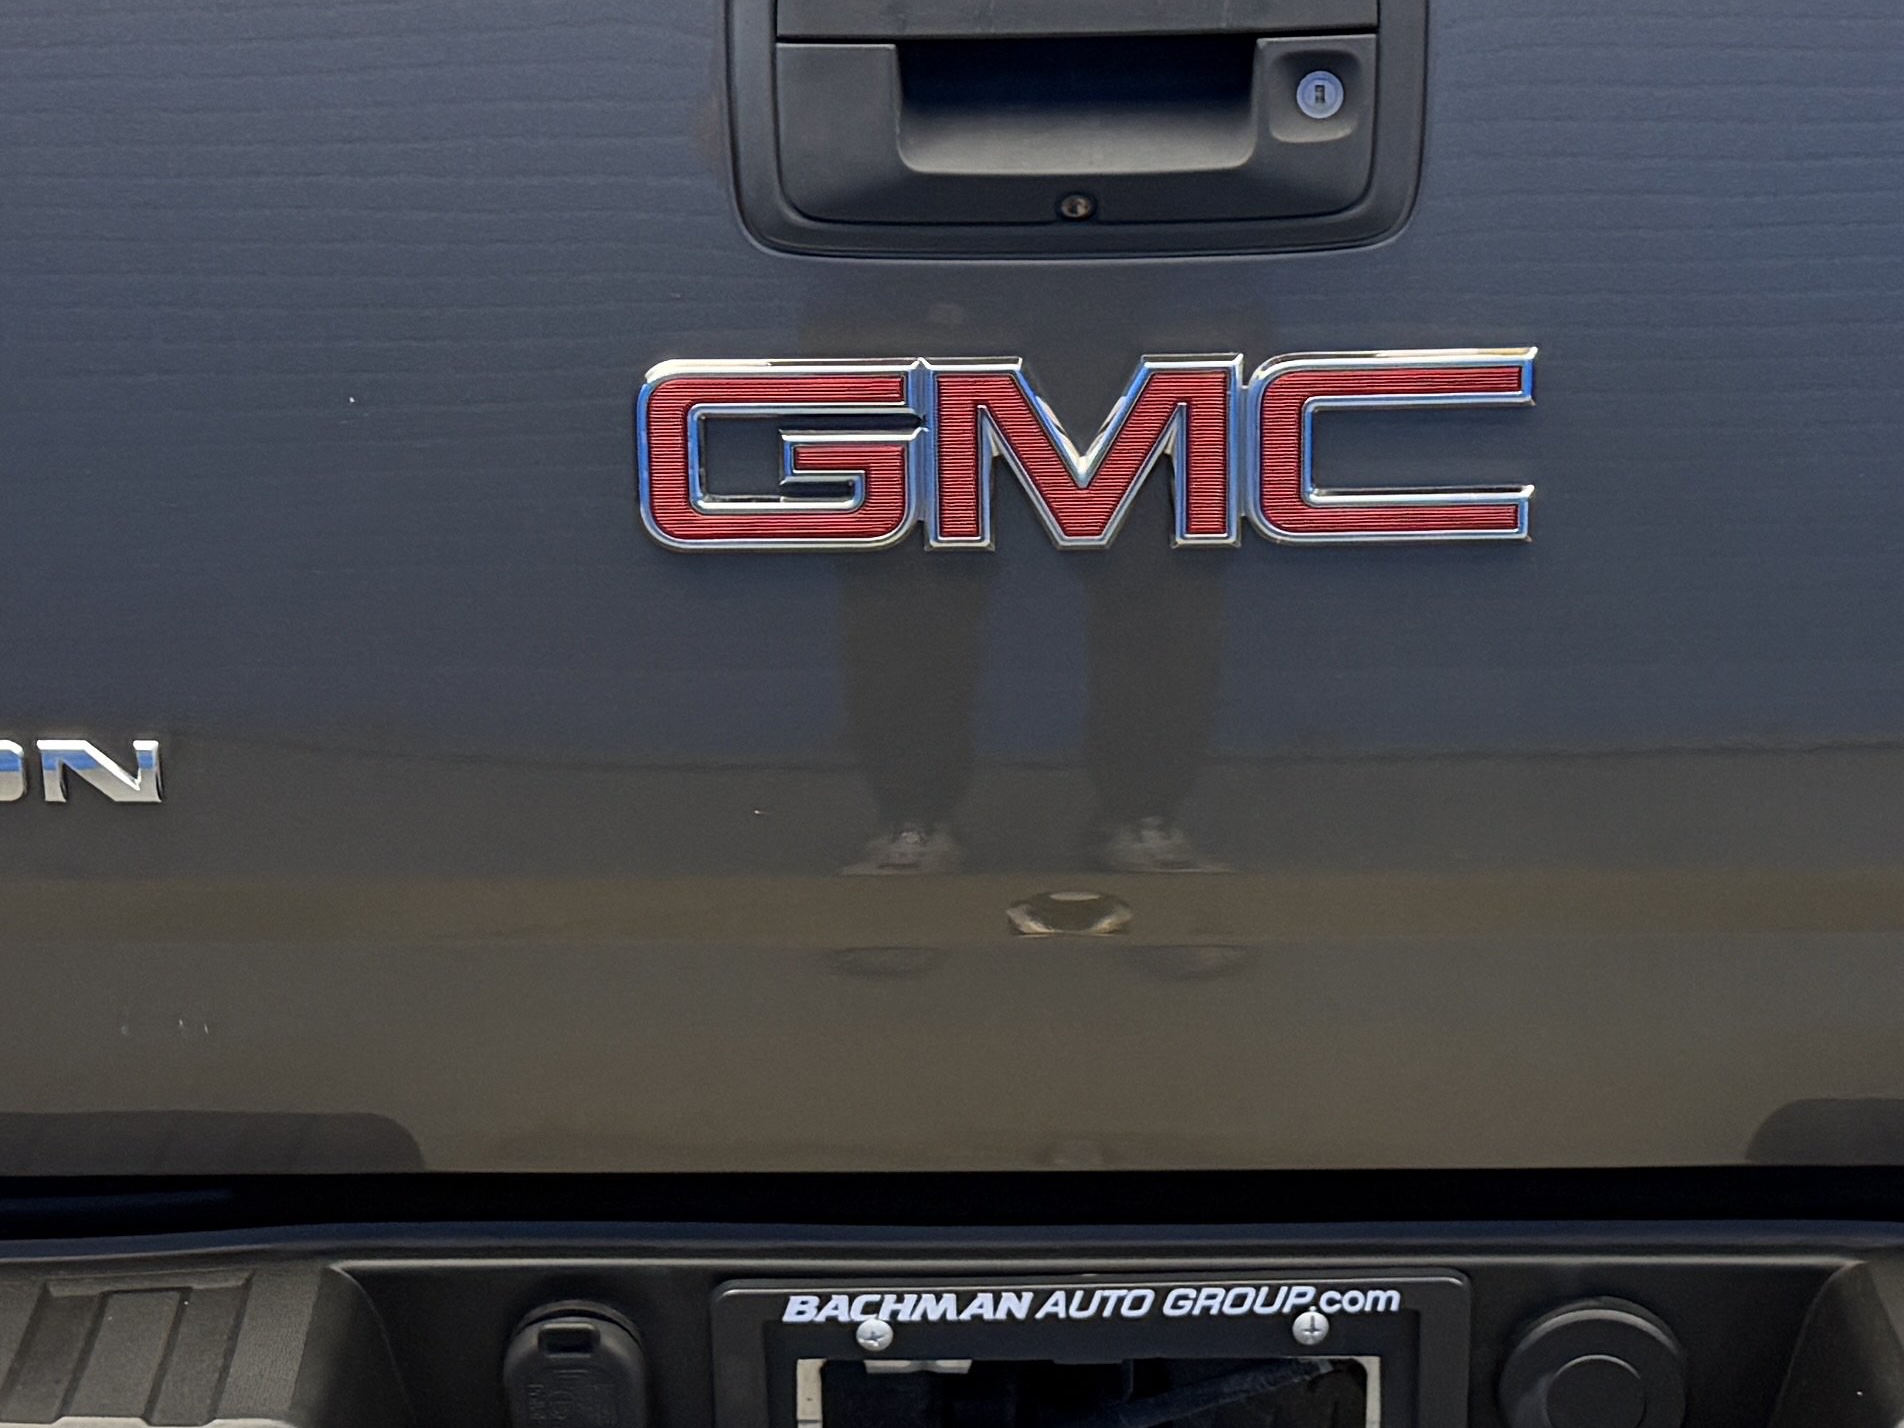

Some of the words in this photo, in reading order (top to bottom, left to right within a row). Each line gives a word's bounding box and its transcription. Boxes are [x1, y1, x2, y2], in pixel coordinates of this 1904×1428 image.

[637, 346, 1538, 552] GMC
[782, 1292, 1034, 1323] BACHMAN
[1035, 1289, 1155, 1319] AUTO
